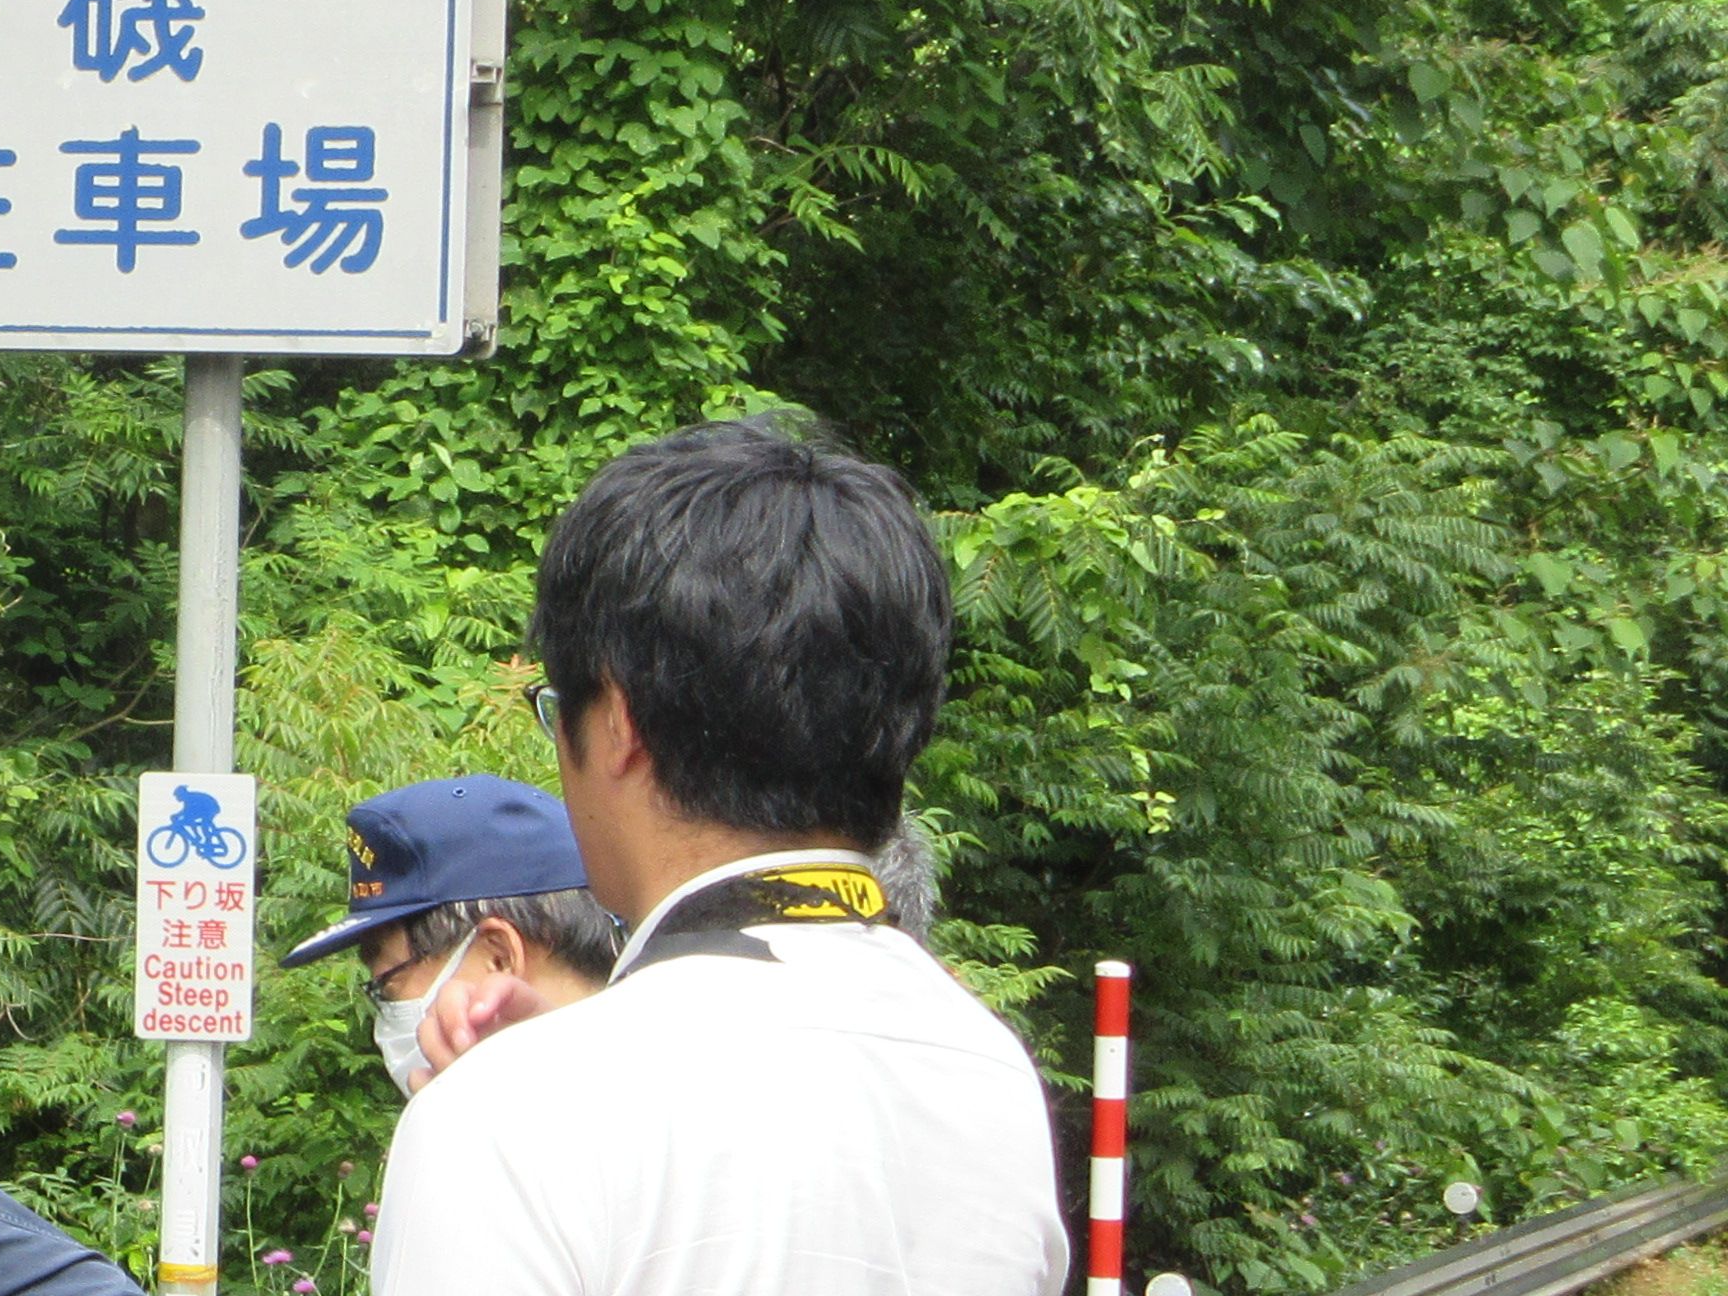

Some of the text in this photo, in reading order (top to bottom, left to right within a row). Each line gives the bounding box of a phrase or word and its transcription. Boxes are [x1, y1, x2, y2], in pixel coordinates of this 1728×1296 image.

[145, 880, 246, 912] 下り坂
[162, 919, 228, 950] 注意
[144, 954, 244, 980] Caution
[158, 981, 229, 1012] Steep
[143, 1008, 243, 1033] descent
